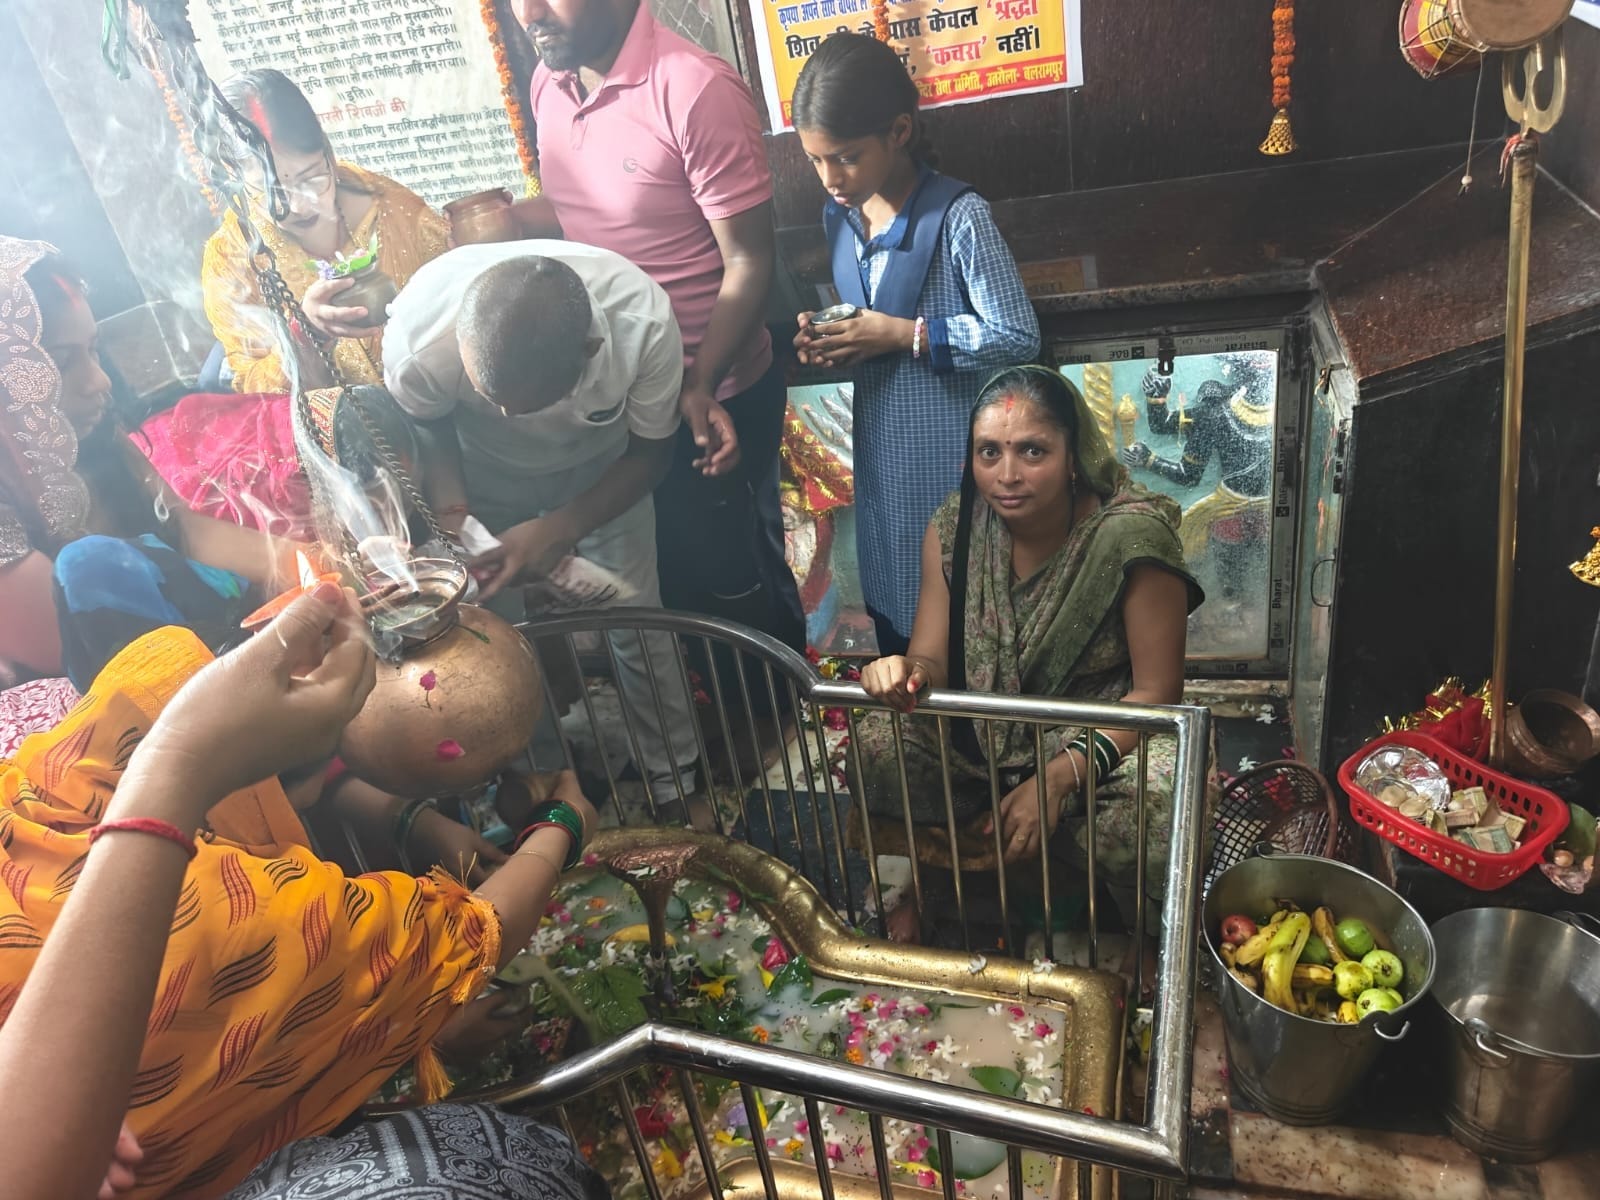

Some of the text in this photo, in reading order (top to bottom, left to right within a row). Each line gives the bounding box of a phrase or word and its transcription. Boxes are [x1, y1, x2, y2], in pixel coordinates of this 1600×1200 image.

[889, 17, 921, 39] पास
[927, 6, 979, 32] केवल
[1023, 61, 1064, 81] बलरामपुर
[390, 96, 406, 113] की
[1271, 578, 1282, 609] Bharat
